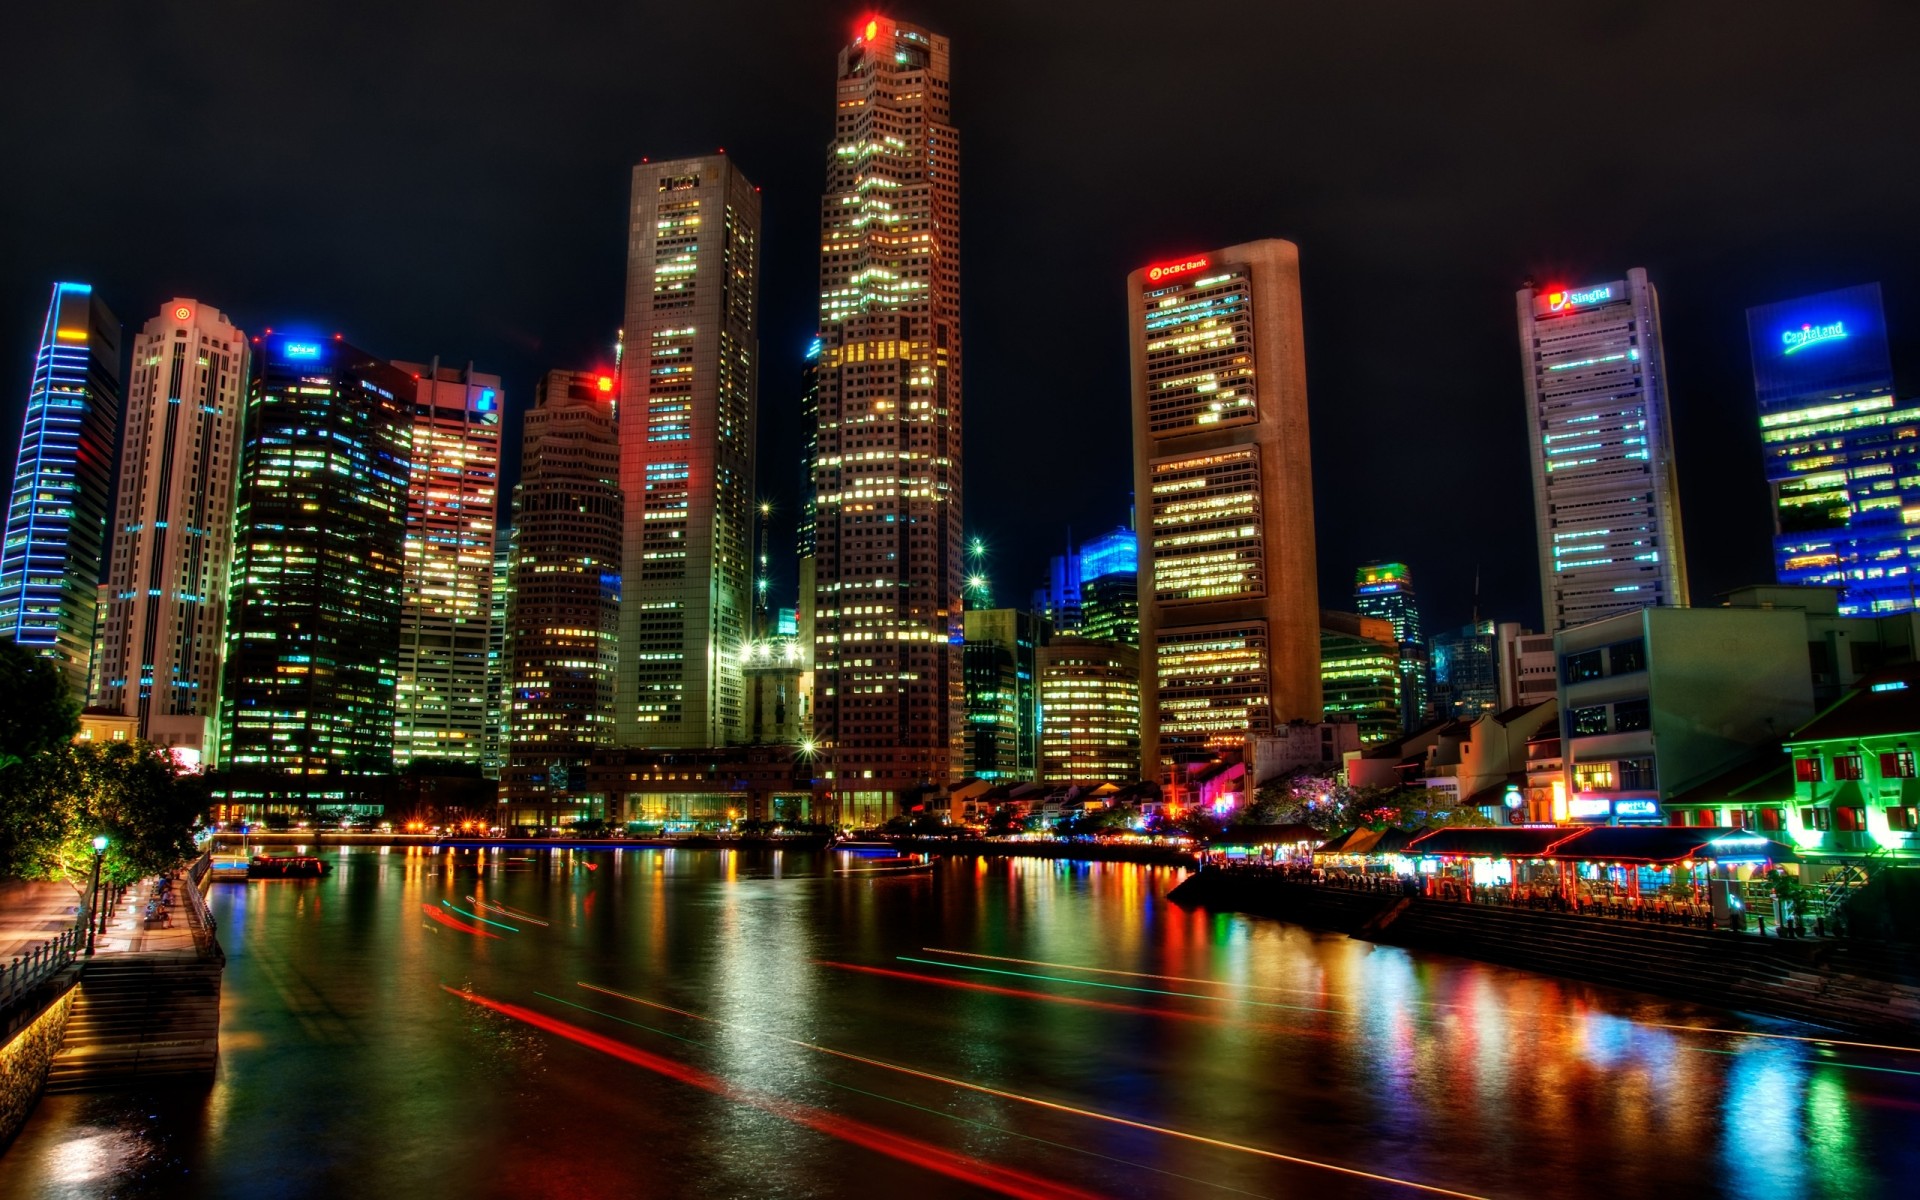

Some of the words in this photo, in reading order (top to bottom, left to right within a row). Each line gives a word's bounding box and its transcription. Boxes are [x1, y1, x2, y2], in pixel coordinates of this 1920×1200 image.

[1162, 264, 1186, 275] OCBC
[1186, 259, 1207, 270] Bank
[1570, 287, 1611, 304] SingTel
[1783, 321, 1843, 344] CapitaLand
